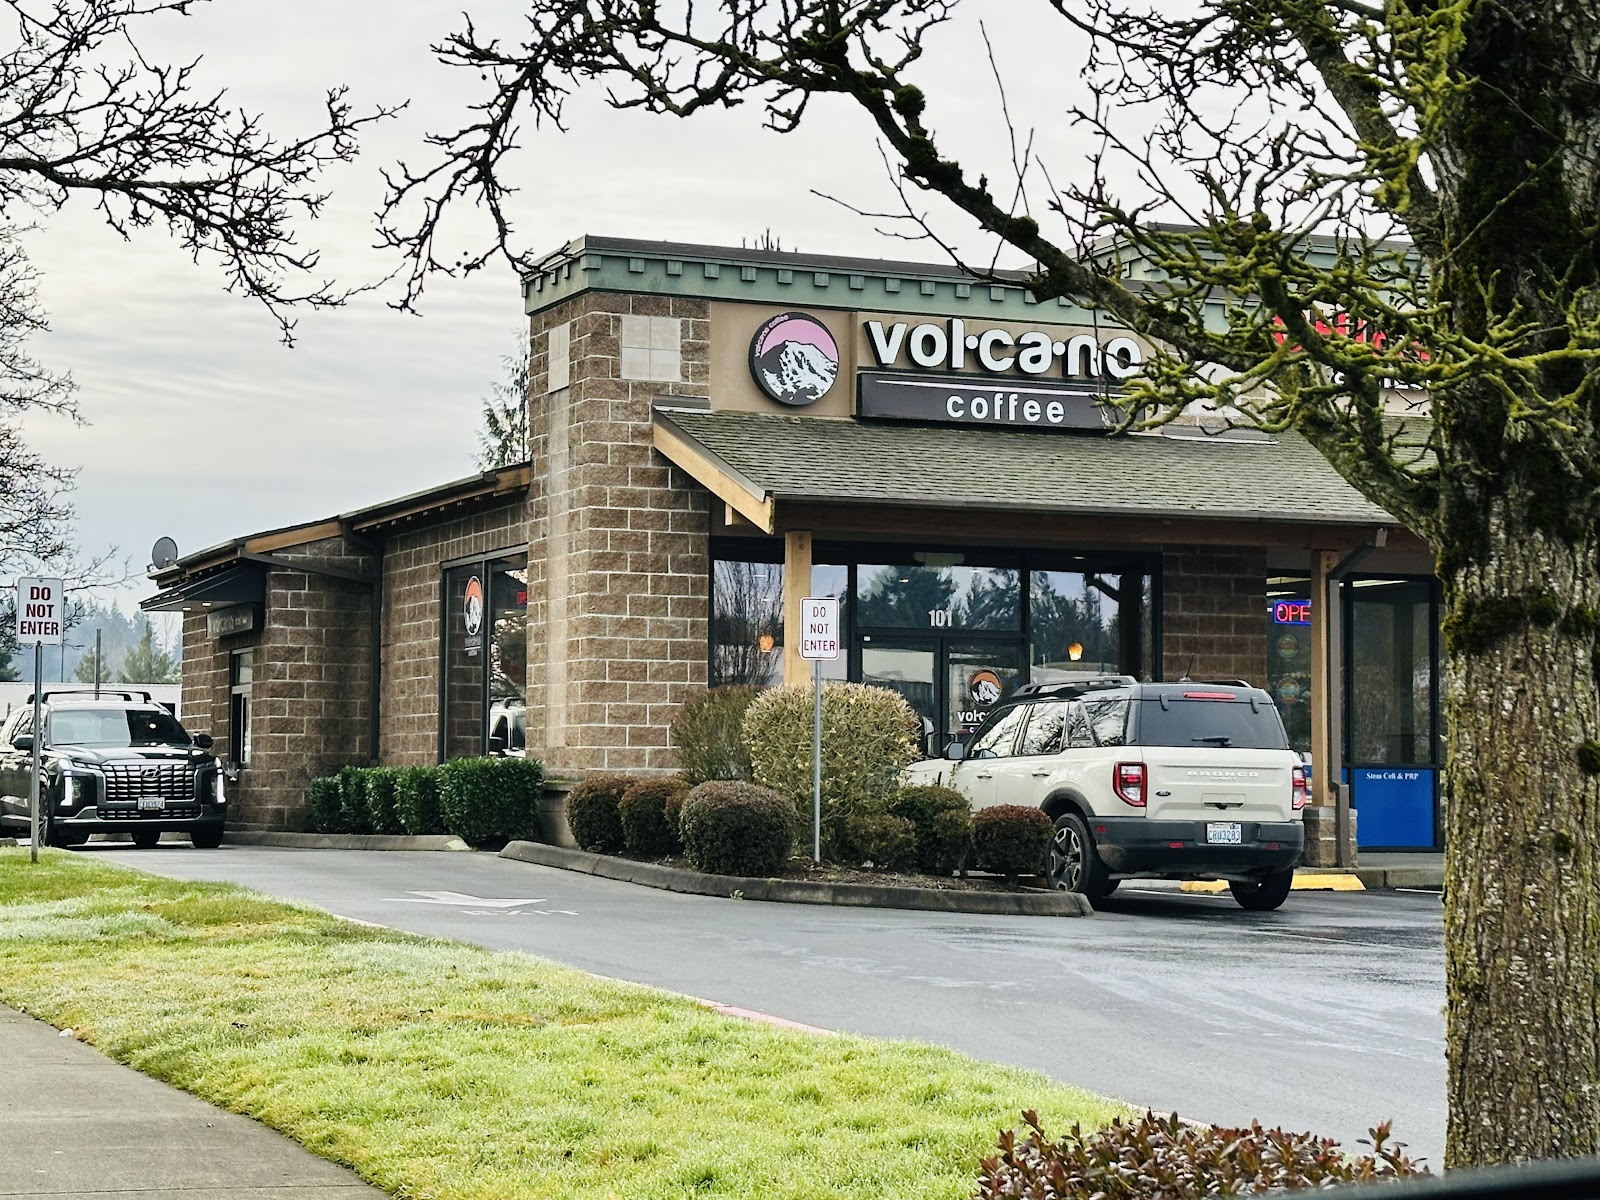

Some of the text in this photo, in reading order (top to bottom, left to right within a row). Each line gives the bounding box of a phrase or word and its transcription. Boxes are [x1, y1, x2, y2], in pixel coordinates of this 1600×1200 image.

[946, 392, 1065, 423] coffee
[30, 586, 51, 601] DO
[26, 603, 54, 618] NOT
[813, 606, 826, 618] DO
[928, 609, 953, 627] 101
[1276, 603, 1311, 622] OPE
[20, 621, 59, 636] ENTER
[810, 623, 829, 635] NOT
[804, 639, 836, 651] ENTER
[1366, 772, 1419, 780] Stem Cell & PRP
